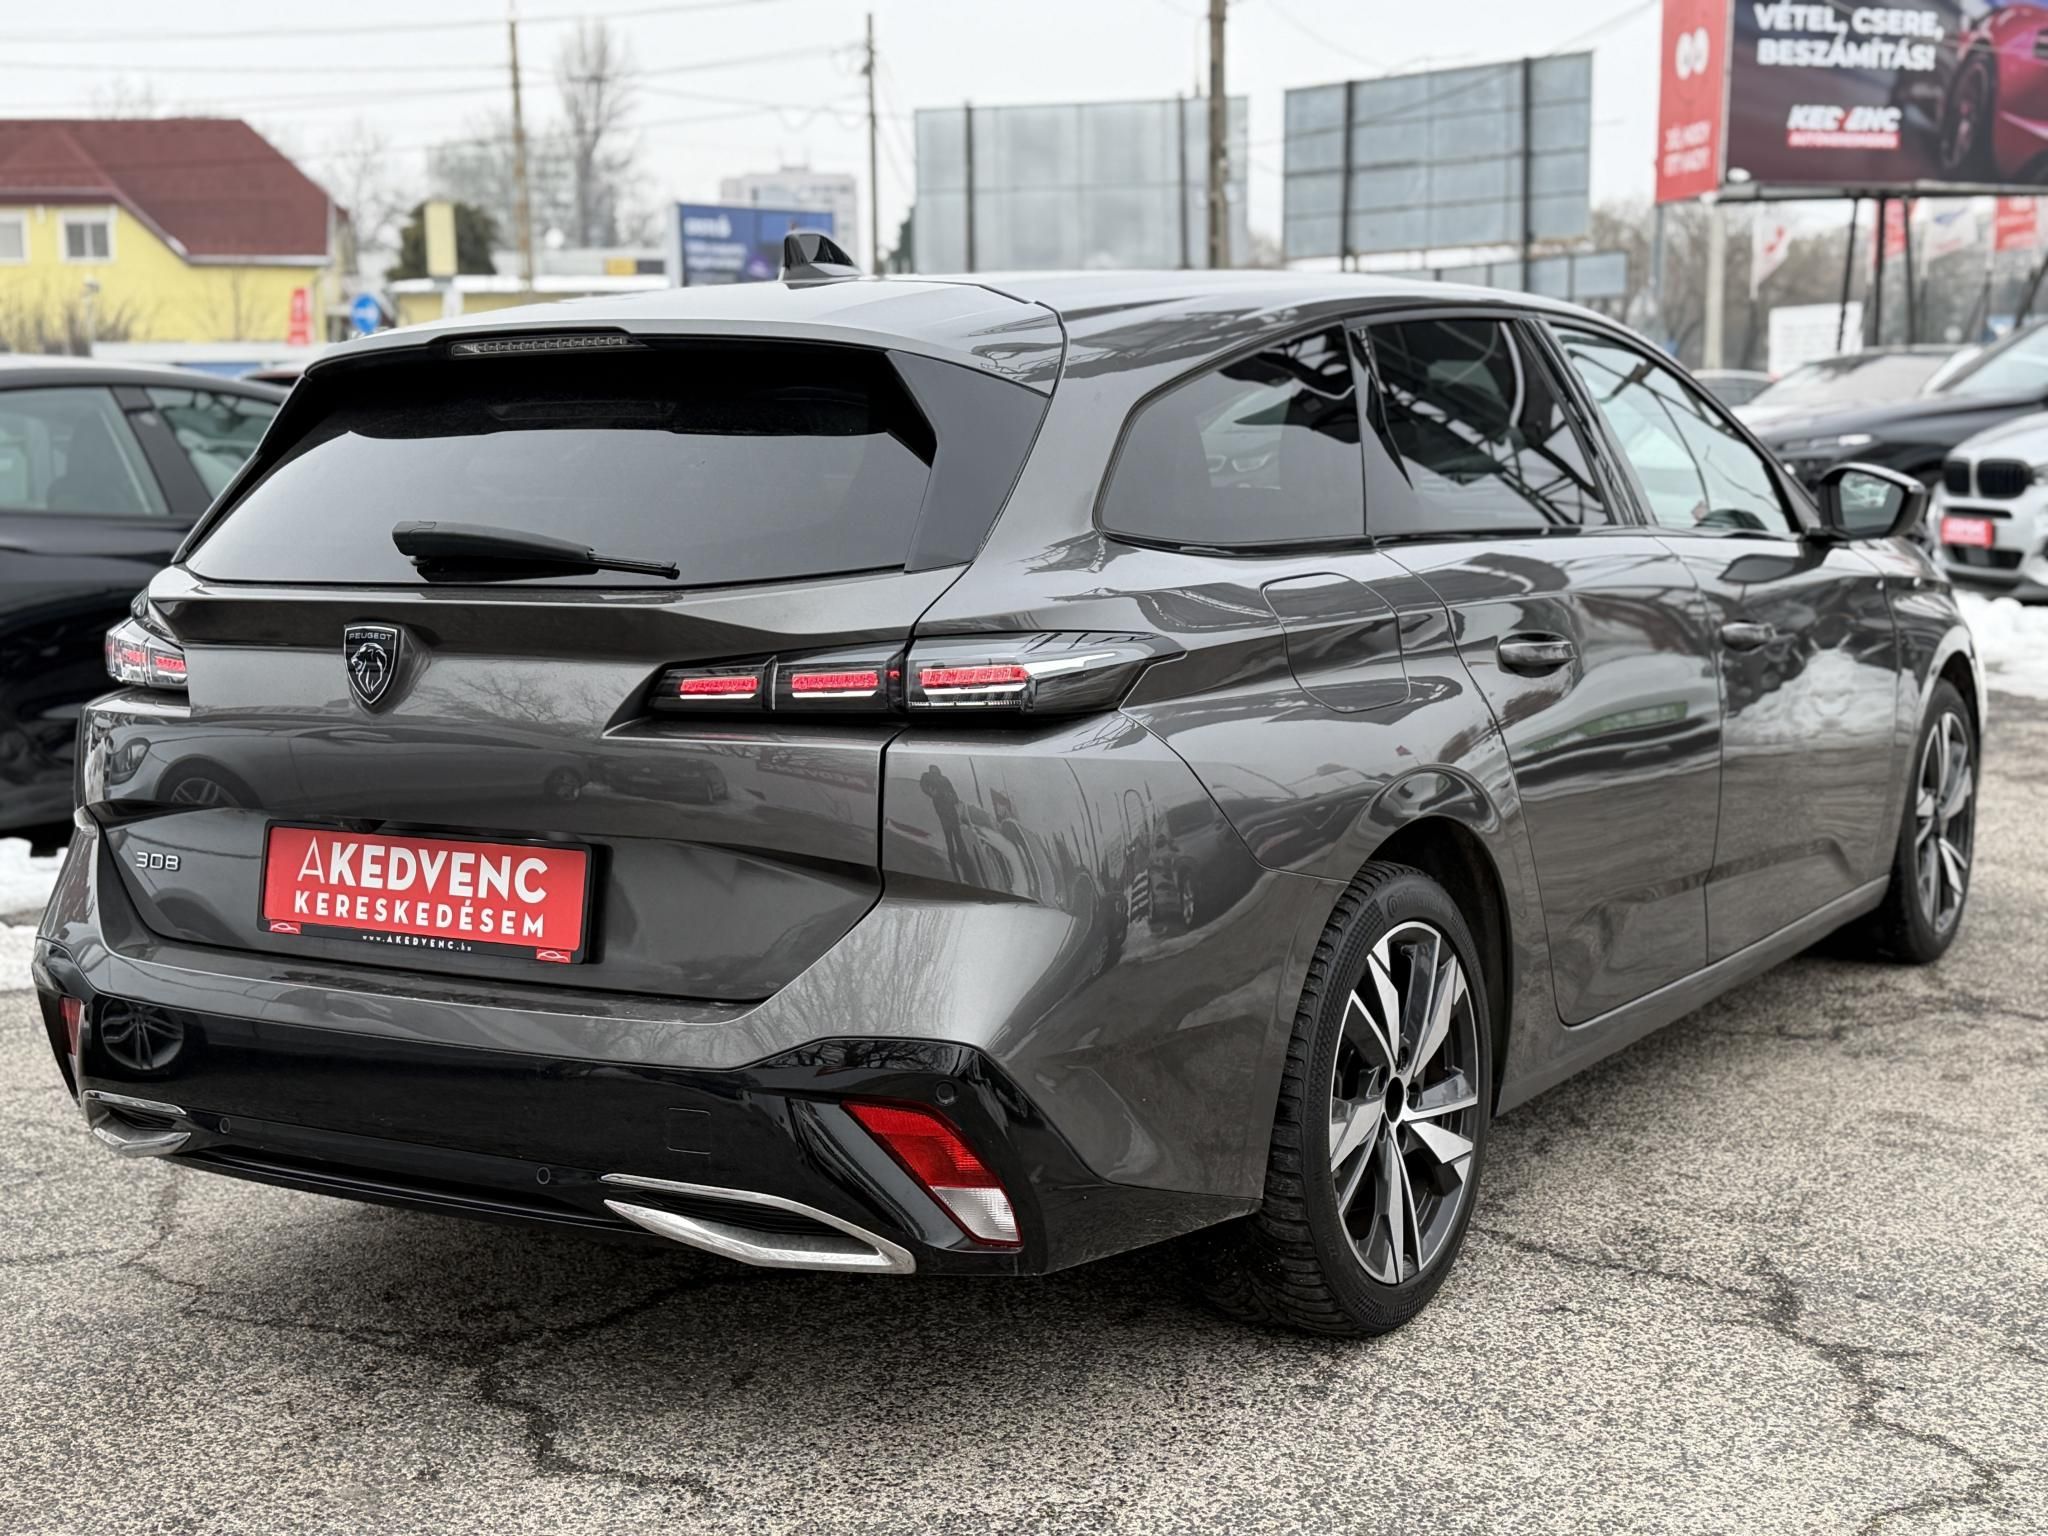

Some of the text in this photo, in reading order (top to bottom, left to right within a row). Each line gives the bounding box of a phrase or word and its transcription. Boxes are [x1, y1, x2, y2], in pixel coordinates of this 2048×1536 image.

[1753, 0, 1945, 41] VÉTEL, CSERE,
[1756, 35, 1937, 71] BESZÁMÍTÁS!
[349, 632, 392, 640] PEUGEOT
[136, 851, 179, 870] 308
[294, 891, 545, 938] KERESKEDÉSEM
[362, 934, 472, 952] www.AKEDVENC.hu
